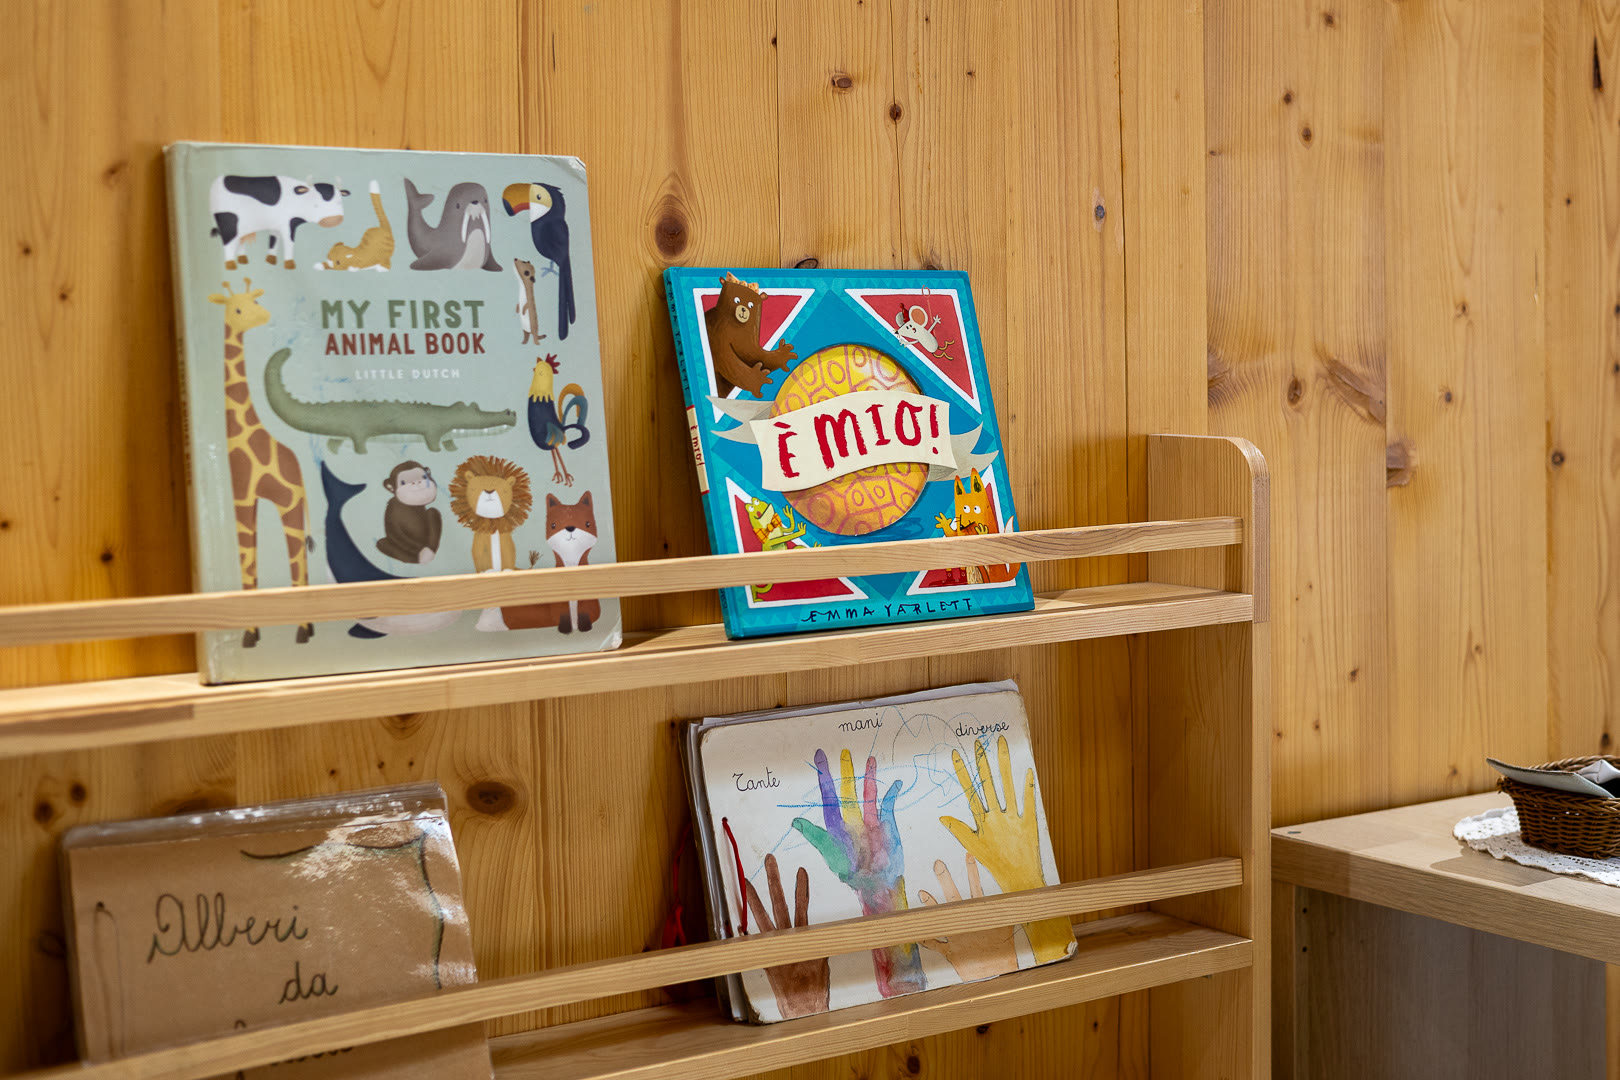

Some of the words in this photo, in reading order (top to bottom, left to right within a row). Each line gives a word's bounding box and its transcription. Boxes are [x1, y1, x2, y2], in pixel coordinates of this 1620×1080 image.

[320, 299, 371, 329] MY
[387, 299, 485, 329] FIRST
[324, 332, 415, 356] ANIMAL
[425, 331, 486, 355] BOOK
[354, 369, 404, 380] LITTLE
[411, 368, 461, 380] DUTCH
[773, 421, 800, 479] È
[813, 400, 940, 472] MIO!
[801, 607, 876, 623] EMMA
[883, 597, 974, 618] YARLETT
[838, 712, 884, 733] mani
[954, 720, 1010, 738] diverse
[731, 766, 782, 793] Tante
[146, 891, 309, 965] Alberi
[277, 960, 339, 1006] da
